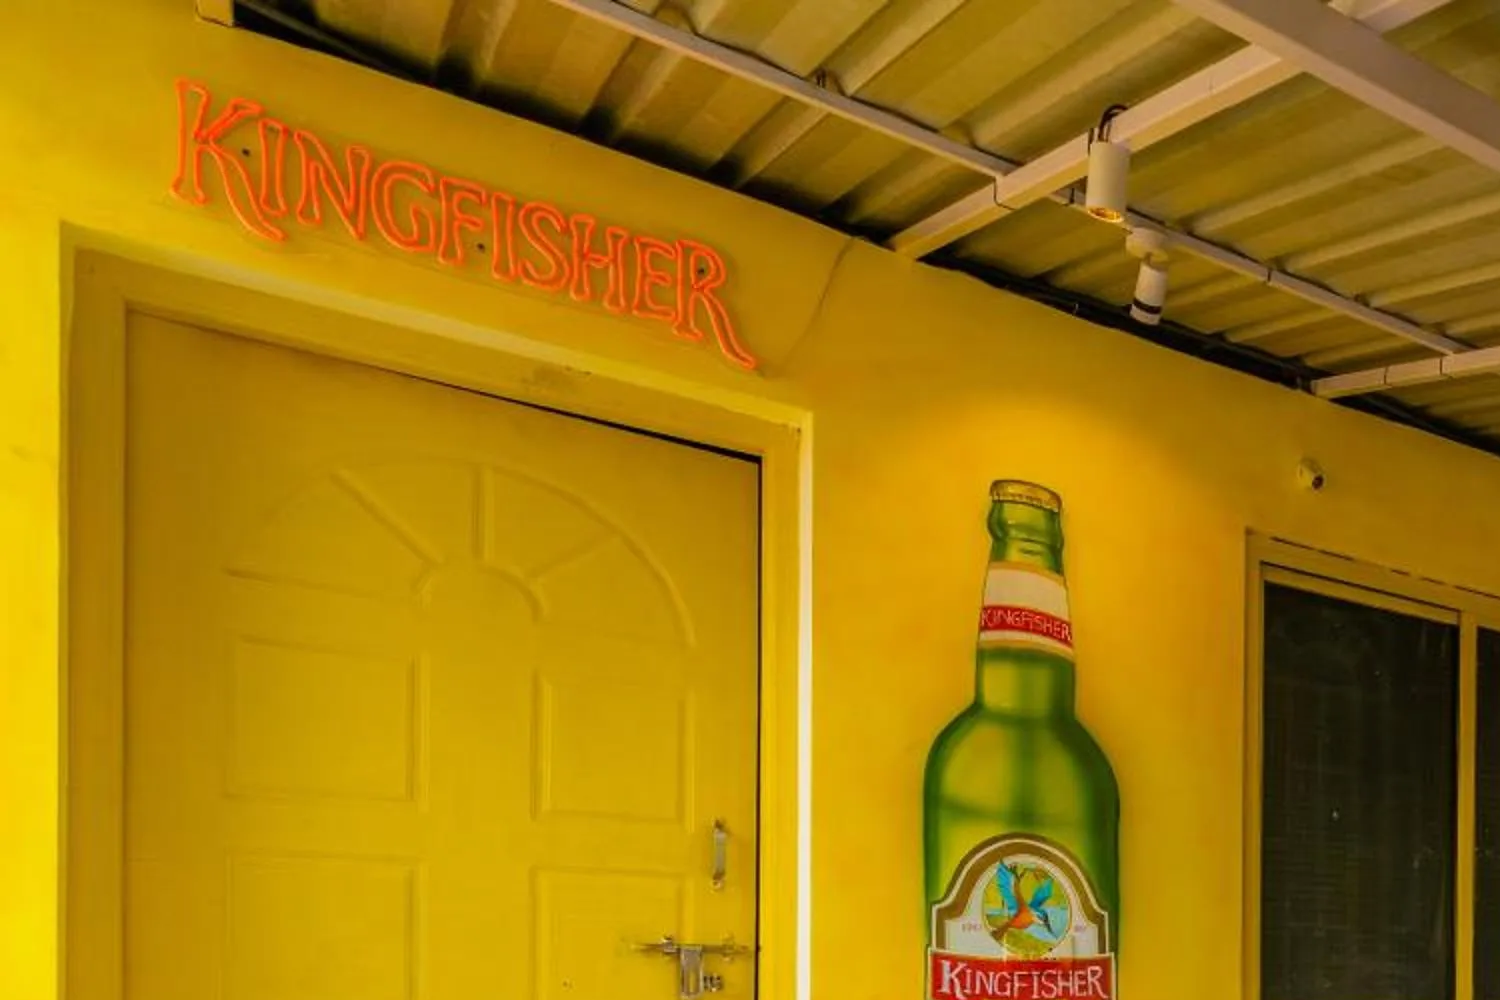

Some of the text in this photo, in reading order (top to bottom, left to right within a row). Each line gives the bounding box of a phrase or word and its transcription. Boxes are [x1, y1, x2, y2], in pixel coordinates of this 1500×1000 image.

[170, 76, 756, 369] KINGFISHER
[981, 608, 1072, 642] KINGFISHER
[938, 959, 1109, 1000] KINGFISHER
